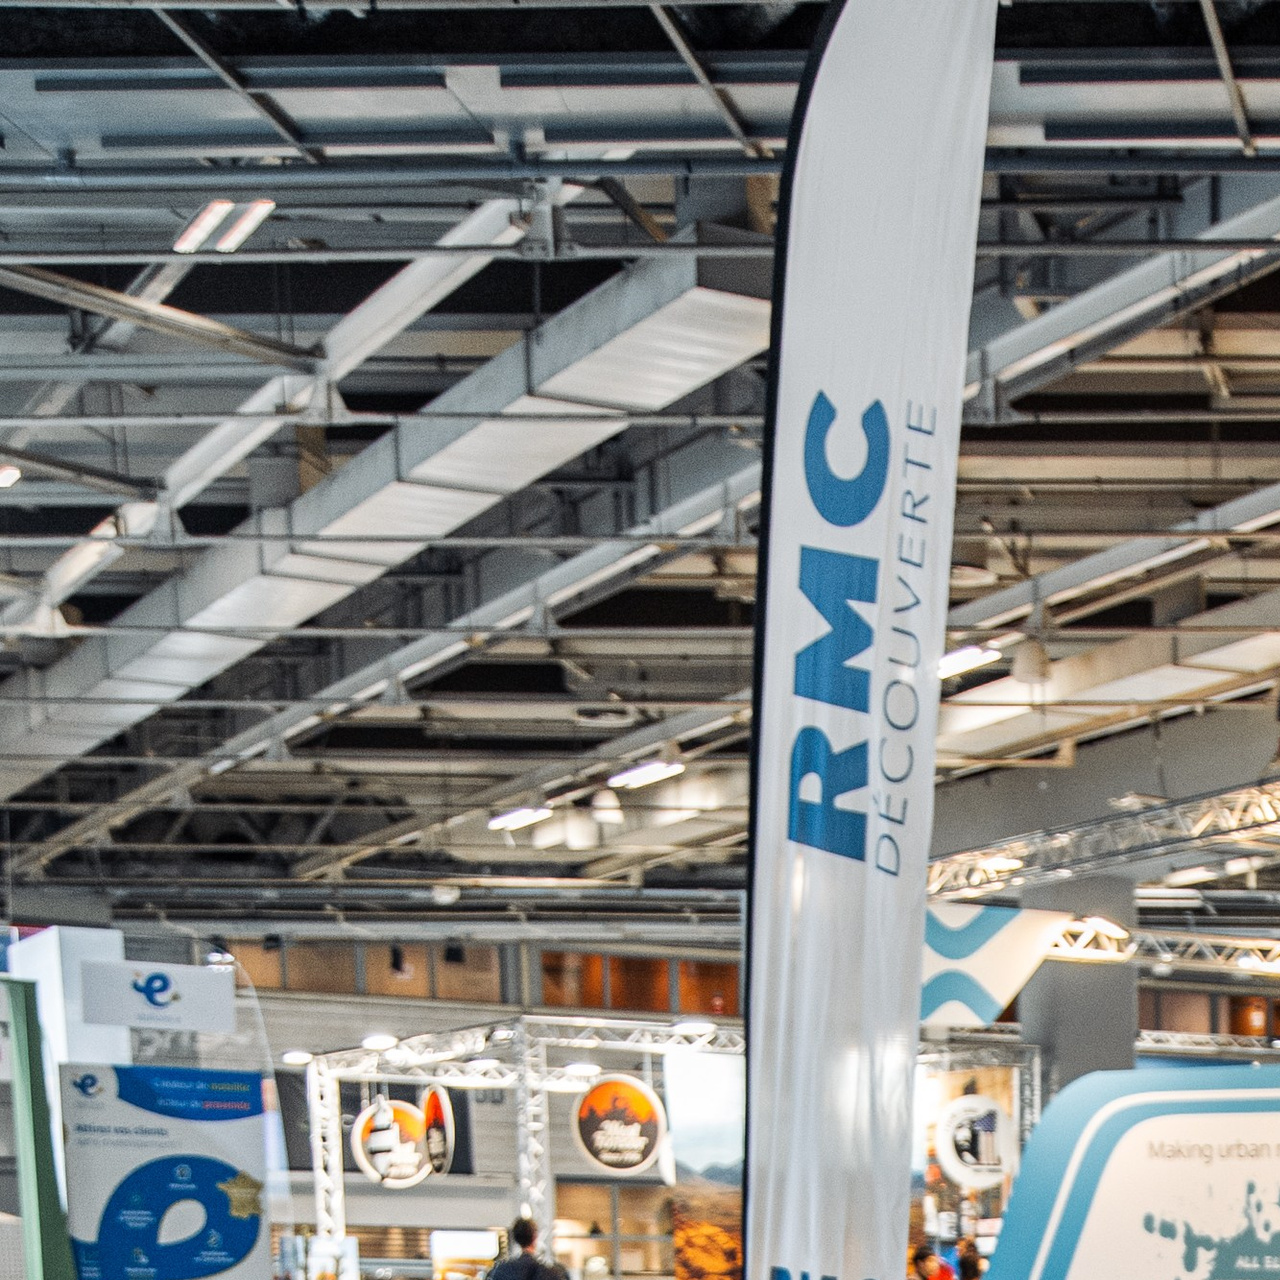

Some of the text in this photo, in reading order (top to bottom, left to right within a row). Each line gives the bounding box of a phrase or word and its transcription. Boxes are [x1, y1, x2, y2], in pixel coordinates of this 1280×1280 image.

[788, 389, 891, 862] RMC
[875, 399, 937, 877] DÉCOUVERTE
[1147, 1140, 1214, 1166] Making
[1218, 1139, 1271, 1160] urban
[1235, 1255, 1261, 1270] ALL
